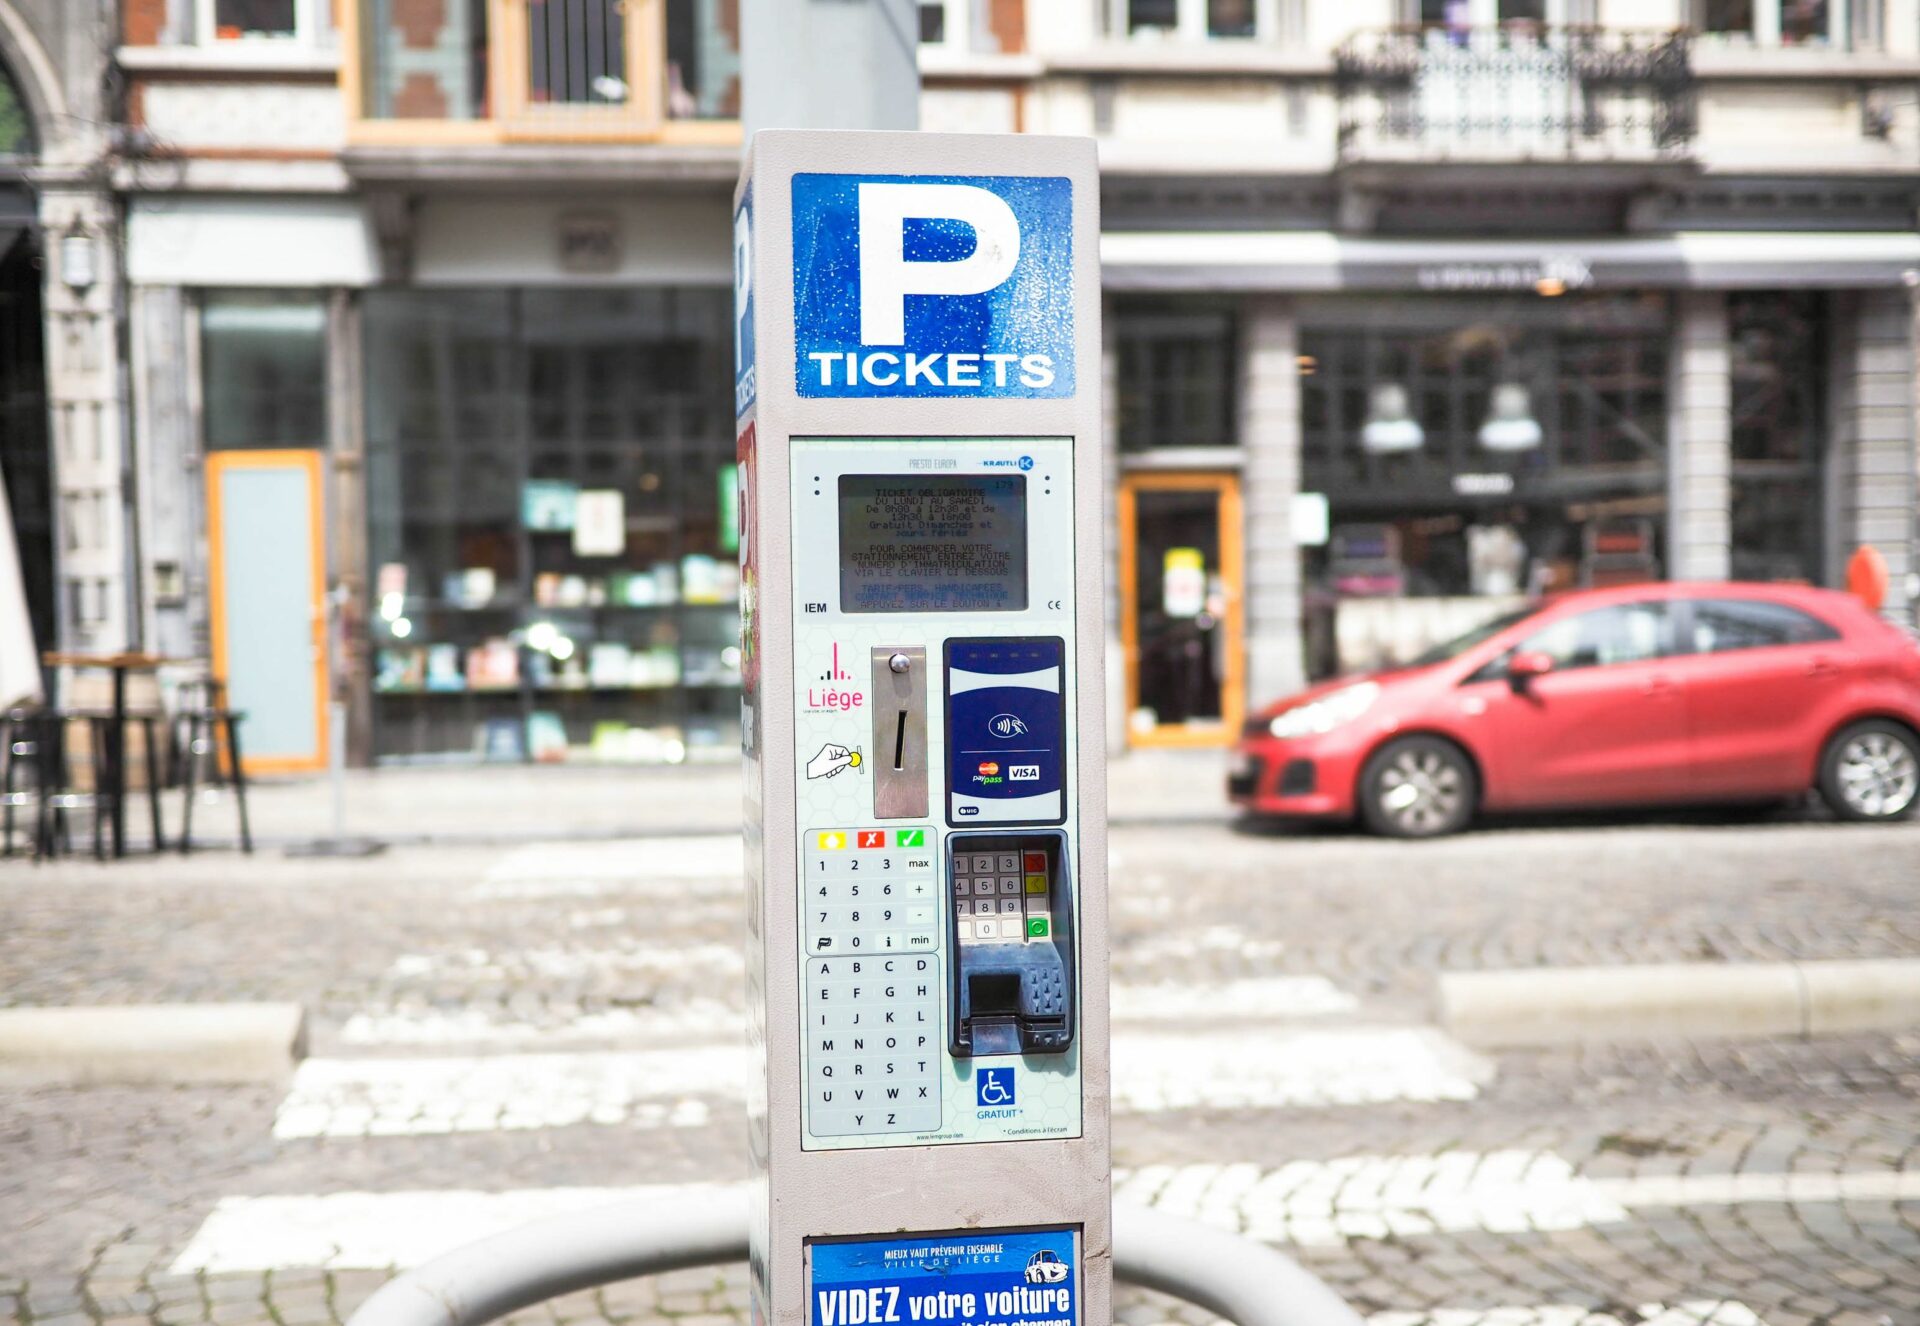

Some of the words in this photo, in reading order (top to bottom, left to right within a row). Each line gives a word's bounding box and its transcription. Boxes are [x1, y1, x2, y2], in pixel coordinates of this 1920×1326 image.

[859, 183, 1020, 346] P
[809, 353, 1055, 388] TICKETS
[909, 459, 932, 469] PRESTO
[935, 459, 957, 469] EUROPA
[875, 489, 913, 497] TICKET
[918, 488, 985, 497] OBLIGATOIRE
[875, 497, 888, 505] DU
[894, 497, 923, 505] LUNDI
[931, 497, 943, 505] AU
[949, 497, 985, 505] SAMEDI
[866, 505, 879, 513] De
[928, 505, 959, 513] 12h30
[983, 505, 995, 513] de
[869, 521, 913, 529] Gratuit
[919, 521, 973, 529] Dimanches
[980, 521, 992, 529] et
[870, 544, 895, 552] POUR
[901, 544, 956, 552] COMMENCER
[962, 544, 992, 552] VOTRE
[852, 552, 930, 561] STATIONNEMENT
[938, 552, 975, 560] ENTREZ
[981, 552, 1010, 560] VOTRE
[855, 569, 874, 577] VIA
[880, 569, 892, 577] LE
[898, 569, 942, 577] CLAVIER
[966, 568, 1009, 576] DESSOUS
[805, 604, 827, 613] IEM
[861, 600, 904, 608] APPUYEZ
[911, 600, 928, 608] SUR
[935, 600, 948, 608] LE
[953, 600, 990, 608] BOUTON
[809, 688, 863, 711] Liège
[1012, 768, 1037, 777] VISA
[820, 861, 825, 871] 1
[851, 860, 859, 870] 2
[883, 859, 891, 869] 3
[980, 860, 987, 870] 2
[1006, 859, 1013, 868] 3
[819, 887, 827, 896] 4
[852, 886, 859, 896] 5
[883, 885, 891, 895] 6
[981, 881, 989, 891] 5
[1007, 880, 1014, 890] 6
[982, 903, 989, 912] 8
[1007, 902, 1014, 912] 9
[820, 912, 827, 922] 7
[852, 911, 860, 921] 8
[884, 910, 892, 920] 9
[886, 936, 892, 947] i
[911, 936, 930, 944] min
[821, 963, 829, 974] A
[853, 962, 861, 973] B
[885, 961, 894, 972] C
[917, 960, 926, 971] D
[822, 989, 829, 1000] E
[854, 988, 861, 998] F
[885, 986, 895, 997] G
[917, 985, 926, 996] H
[853, 1013, 859, 1024] J
[886, 1012, 894, 1023] K
[918, 1011, 925, 1022] L
[822, 1040, 833, 1051] M
[854, 1039, 864, 1049] N
[886, 1037, 896, 1049] O
[918, 1036, 926, 1047] P
[823, 1065, 833, 1077] Q
[855, 1064, 863, 1075] R
[886, 1063, 894, 1074] S
[918, 1061, 926, 1072] T
[823, 1091, 832, 1102] U
[855, 1090, 864, 1100] V
[887, 1088, 899, 1099] W
[918, 1087, 927, 1098] X
[855, 1115, 864, 1125] Y
[887, 1114, 896, 1124] Z
[977, 1110, 1017, 1119] GRATUIT
[884, 1249, 908, 1260] MIEUX
[910, 1248, 929, 1259] VAUT
[930, 1244, 965, 1257] PRÉVENIR
[967, 1243, 1003, 1255] ENSEMBLE
[884, 1260, 925, 1269] VILLE
[933, 1258, 949, 1266] DE
[958, 1254, 1000, 1264] LIÈGE
[818, 1286, 900, 1326] VIDEZ
[909, 1290, 976, 1321] votre
[985, 1285, 1070, 1317] voiture
